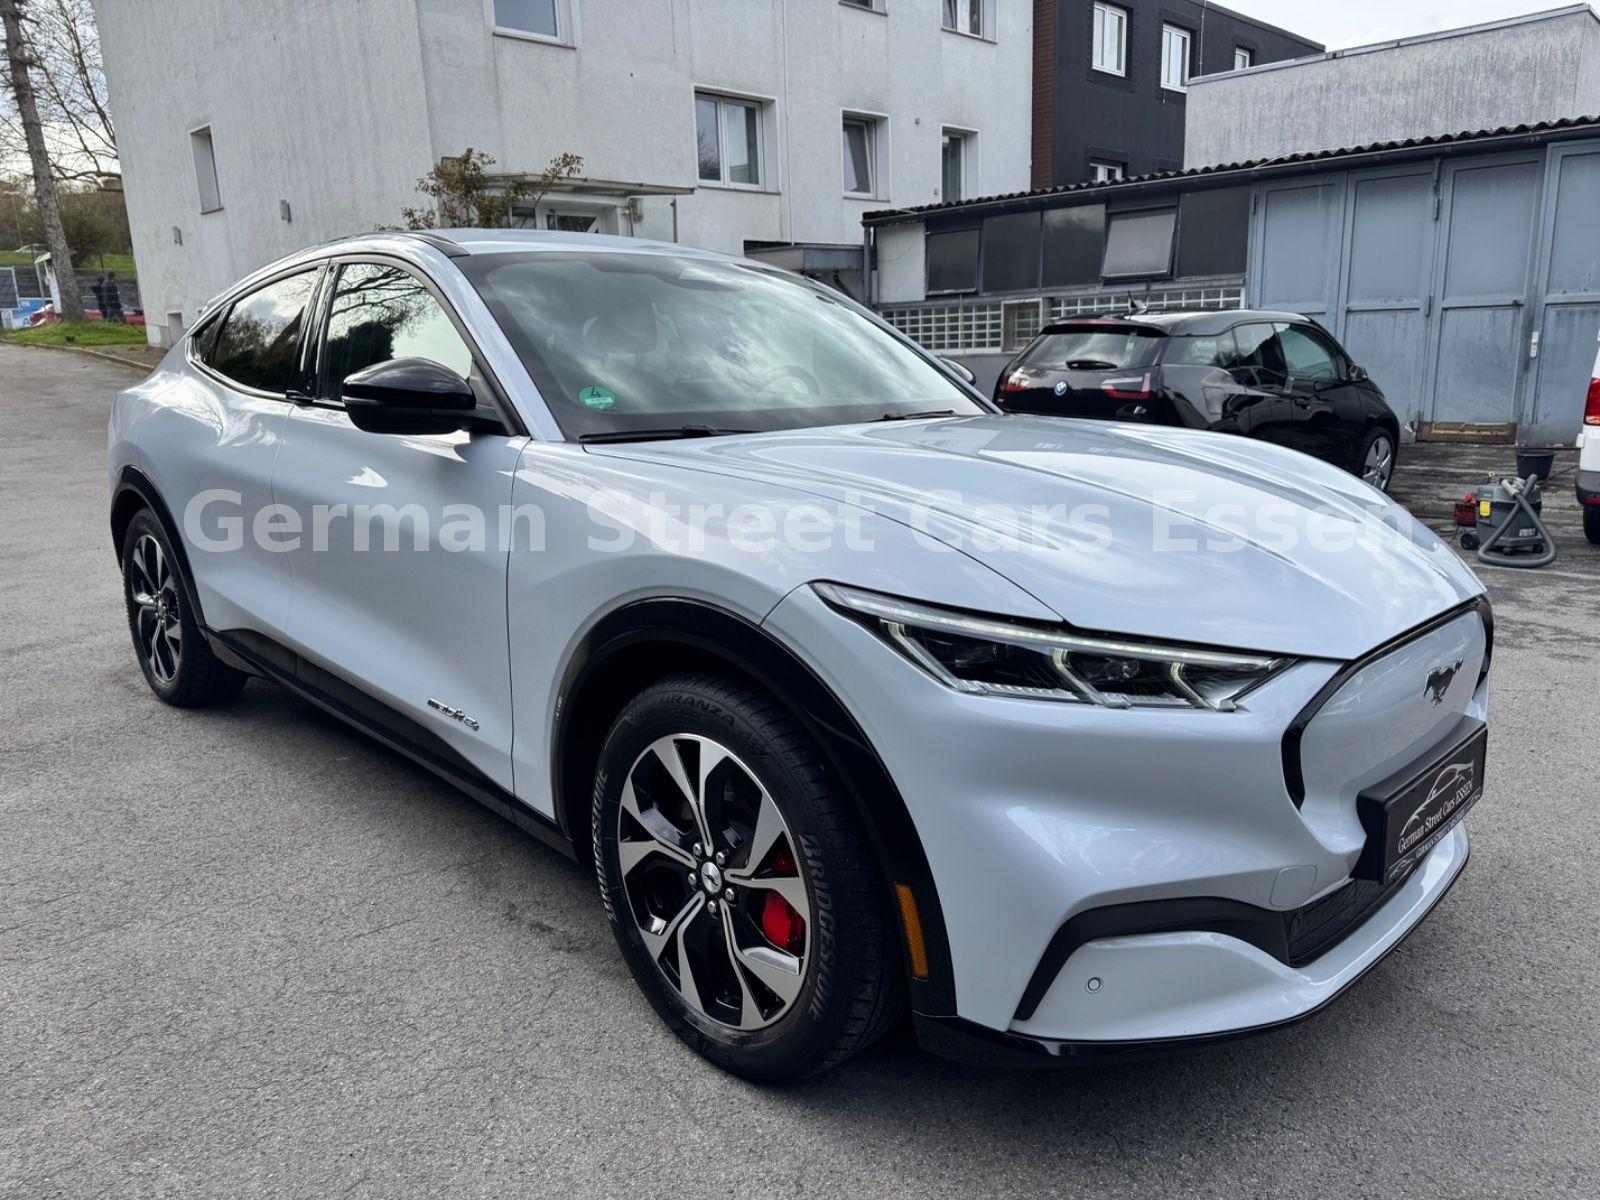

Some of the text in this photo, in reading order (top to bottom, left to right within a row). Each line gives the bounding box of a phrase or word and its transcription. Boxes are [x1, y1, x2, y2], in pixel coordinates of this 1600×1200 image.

[1398, 825, 1425, 853] German
[1424, 807, 1443, 832] Street
[798, 832, 837, 1024] BRIDGESTONE
